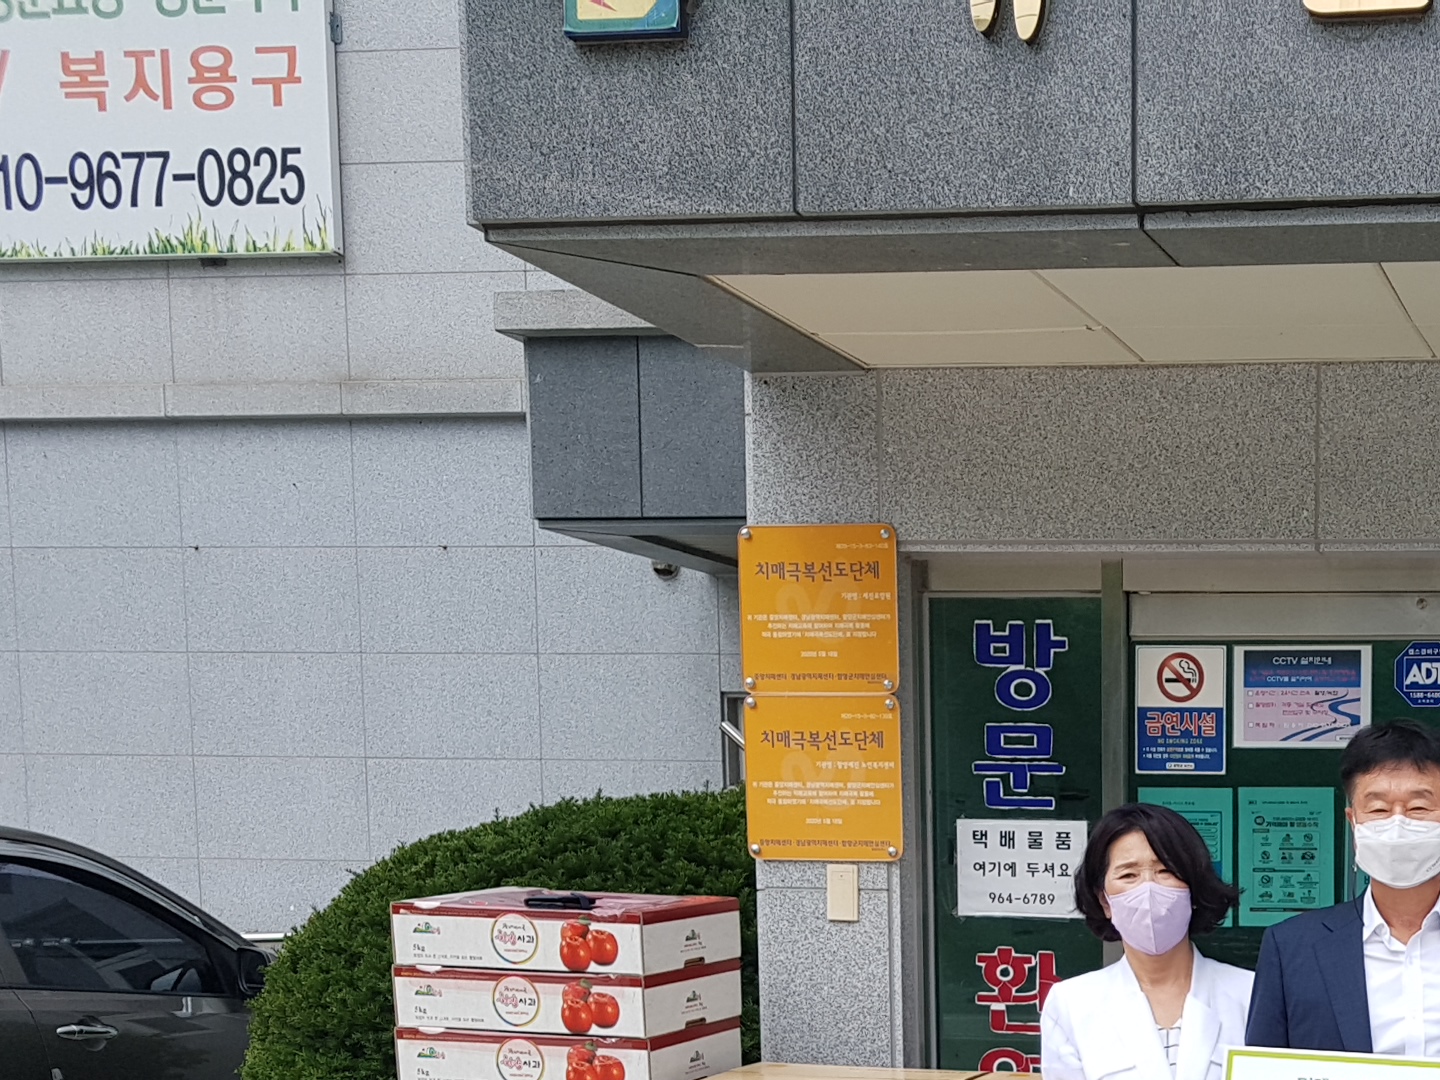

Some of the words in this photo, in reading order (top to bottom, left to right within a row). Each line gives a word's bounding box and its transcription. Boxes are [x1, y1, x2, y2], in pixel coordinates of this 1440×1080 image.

[58, 44, 303, 113] 복지용구
[754, 560, 881, 583] 치매극복선도단체
[1272, 656, 1299, 666] CCTV
[1144, 711, 1217, 737] 금연시설
[760, 730, 885, 751] 치매극복선도단체
[972, 861, 1017, 878] 여기에
[988, 891, 1056, 906] 964-6789
